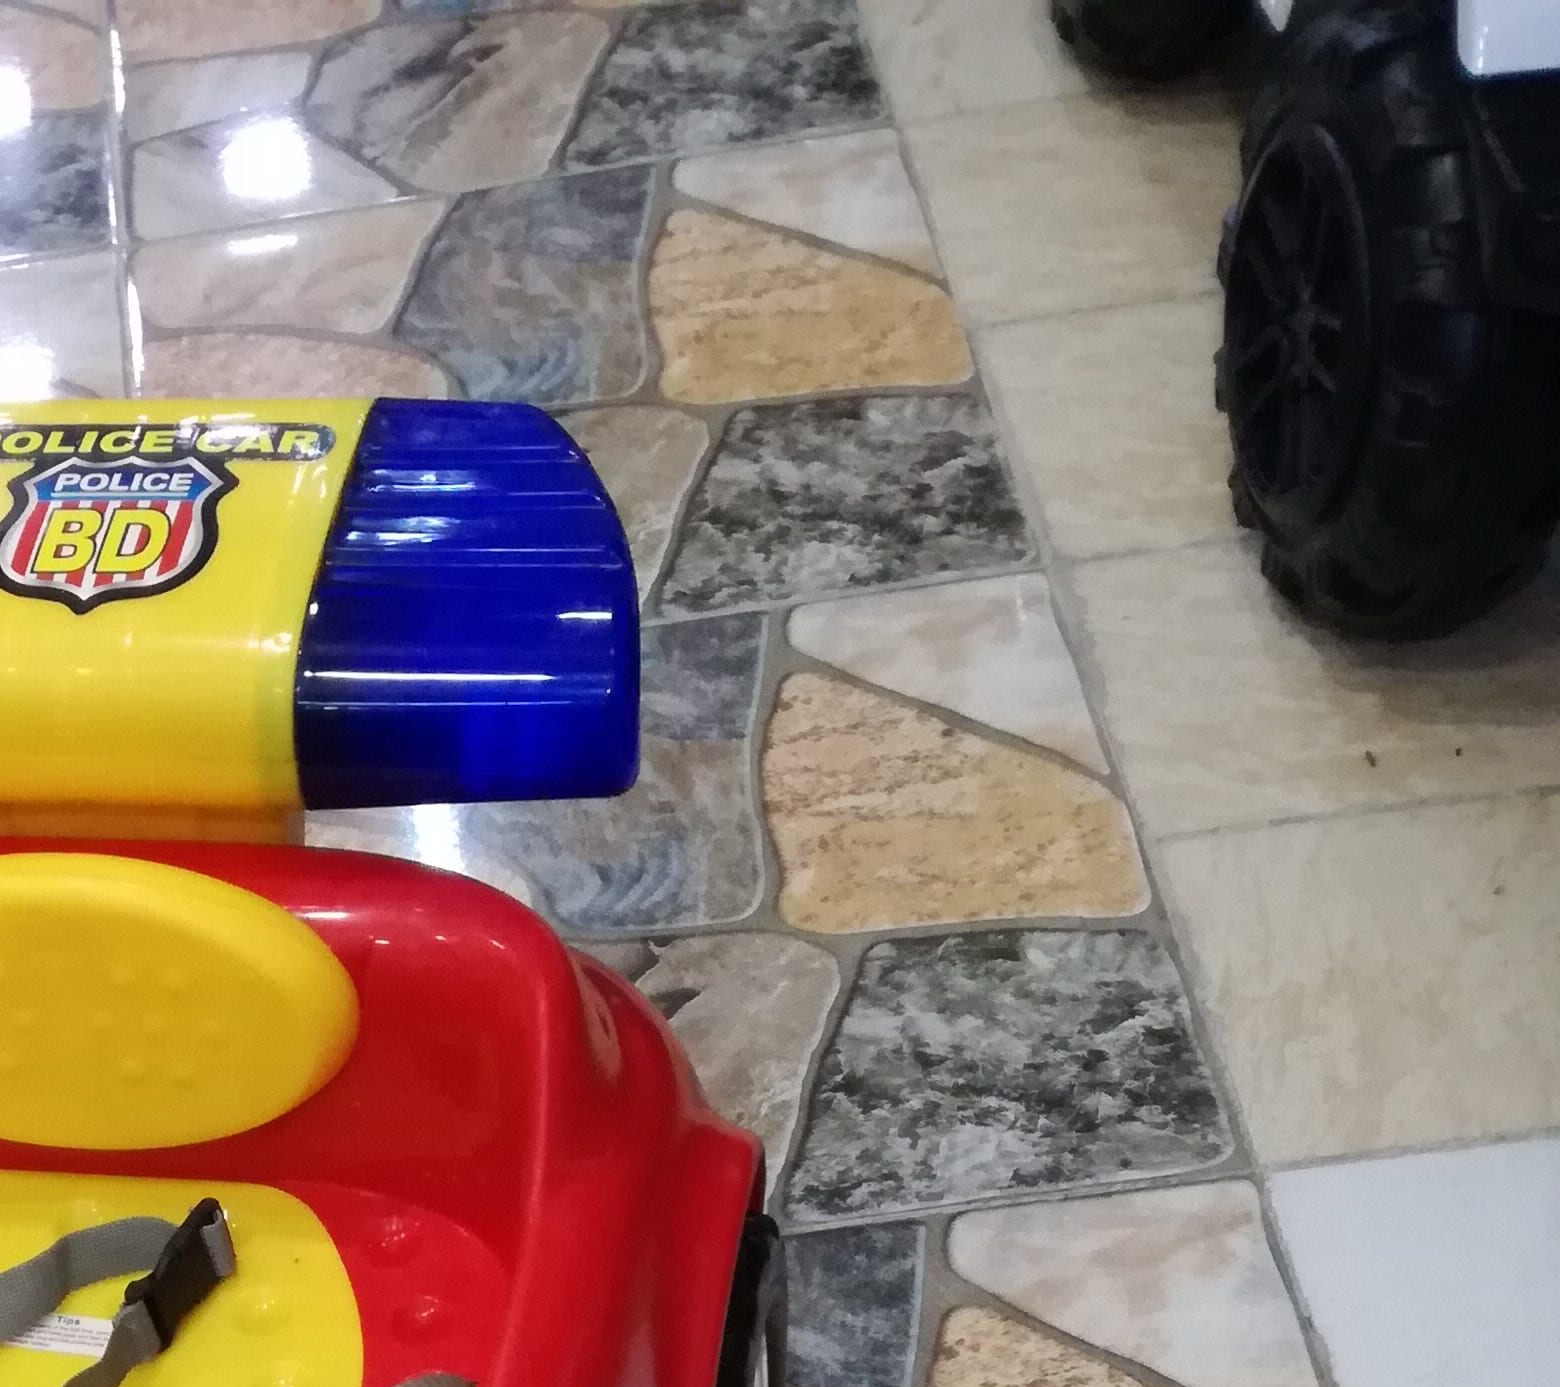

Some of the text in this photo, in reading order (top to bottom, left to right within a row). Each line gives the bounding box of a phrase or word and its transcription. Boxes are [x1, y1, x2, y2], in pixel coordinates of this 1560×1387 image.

[196, 430, 318, 455] CAR
[53, 471, 194, 493] POLICE
[32, 508, 172, 574] BD
[57, 1315, 80, 1325] Tips
